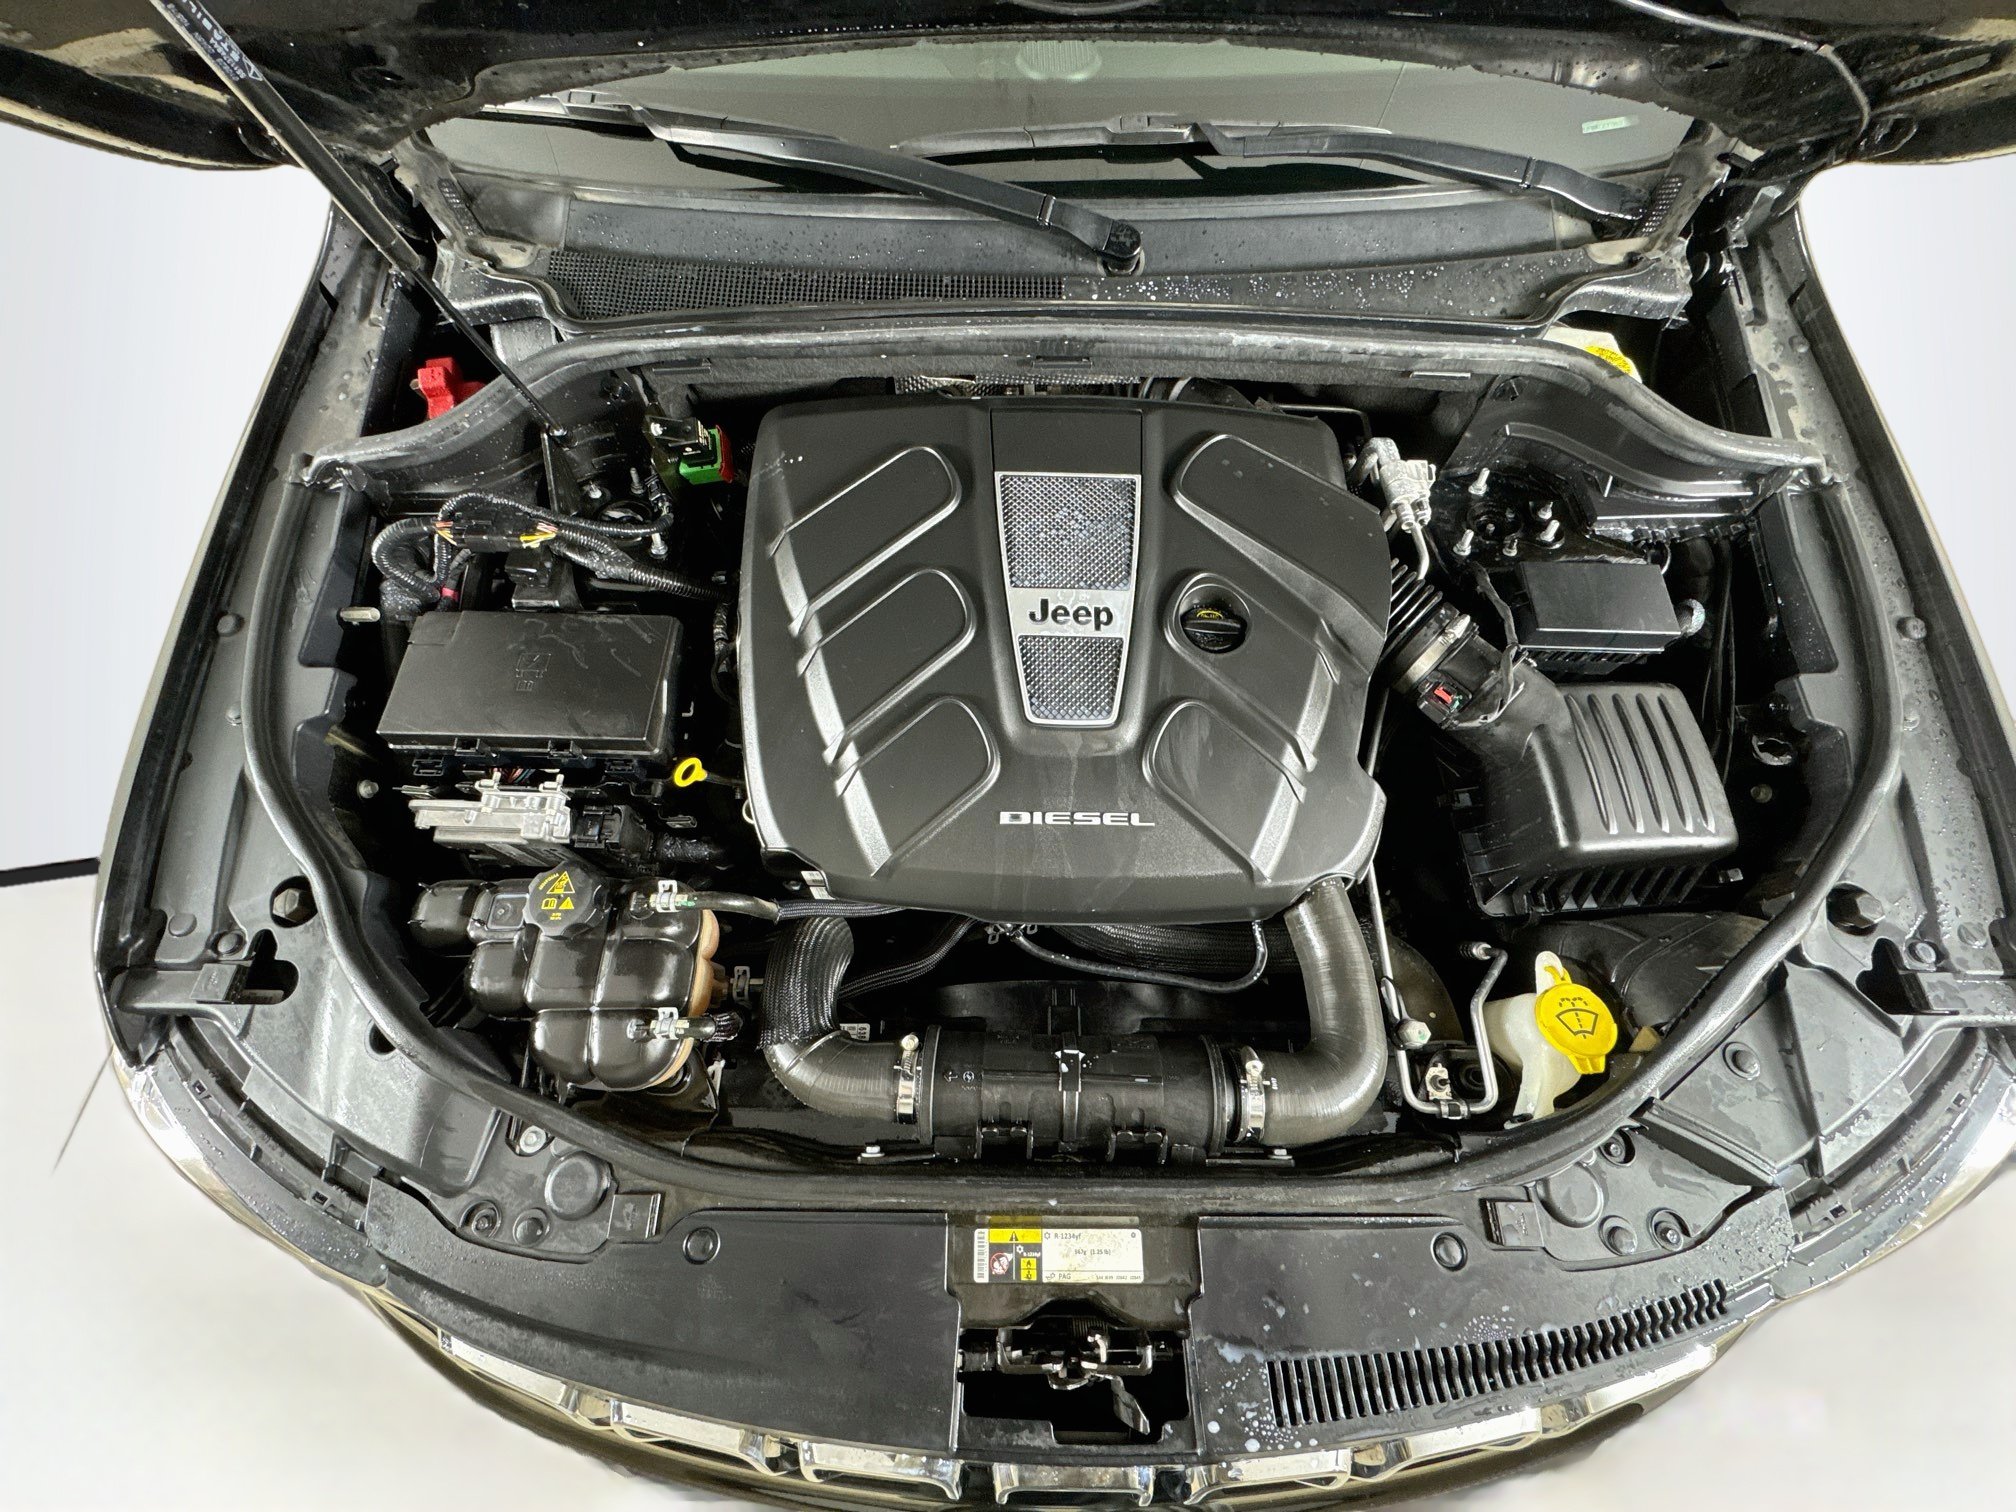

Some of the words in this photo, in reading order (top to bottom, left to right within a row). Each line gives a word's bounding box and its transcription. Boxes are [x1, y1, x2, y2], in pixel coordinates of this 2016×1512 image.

[1028, 598, 1114, 632] Jeep
[999, 811, 1156, 827] DIESEL
[1054, 1232, 1081, 1240] R-1234yf
